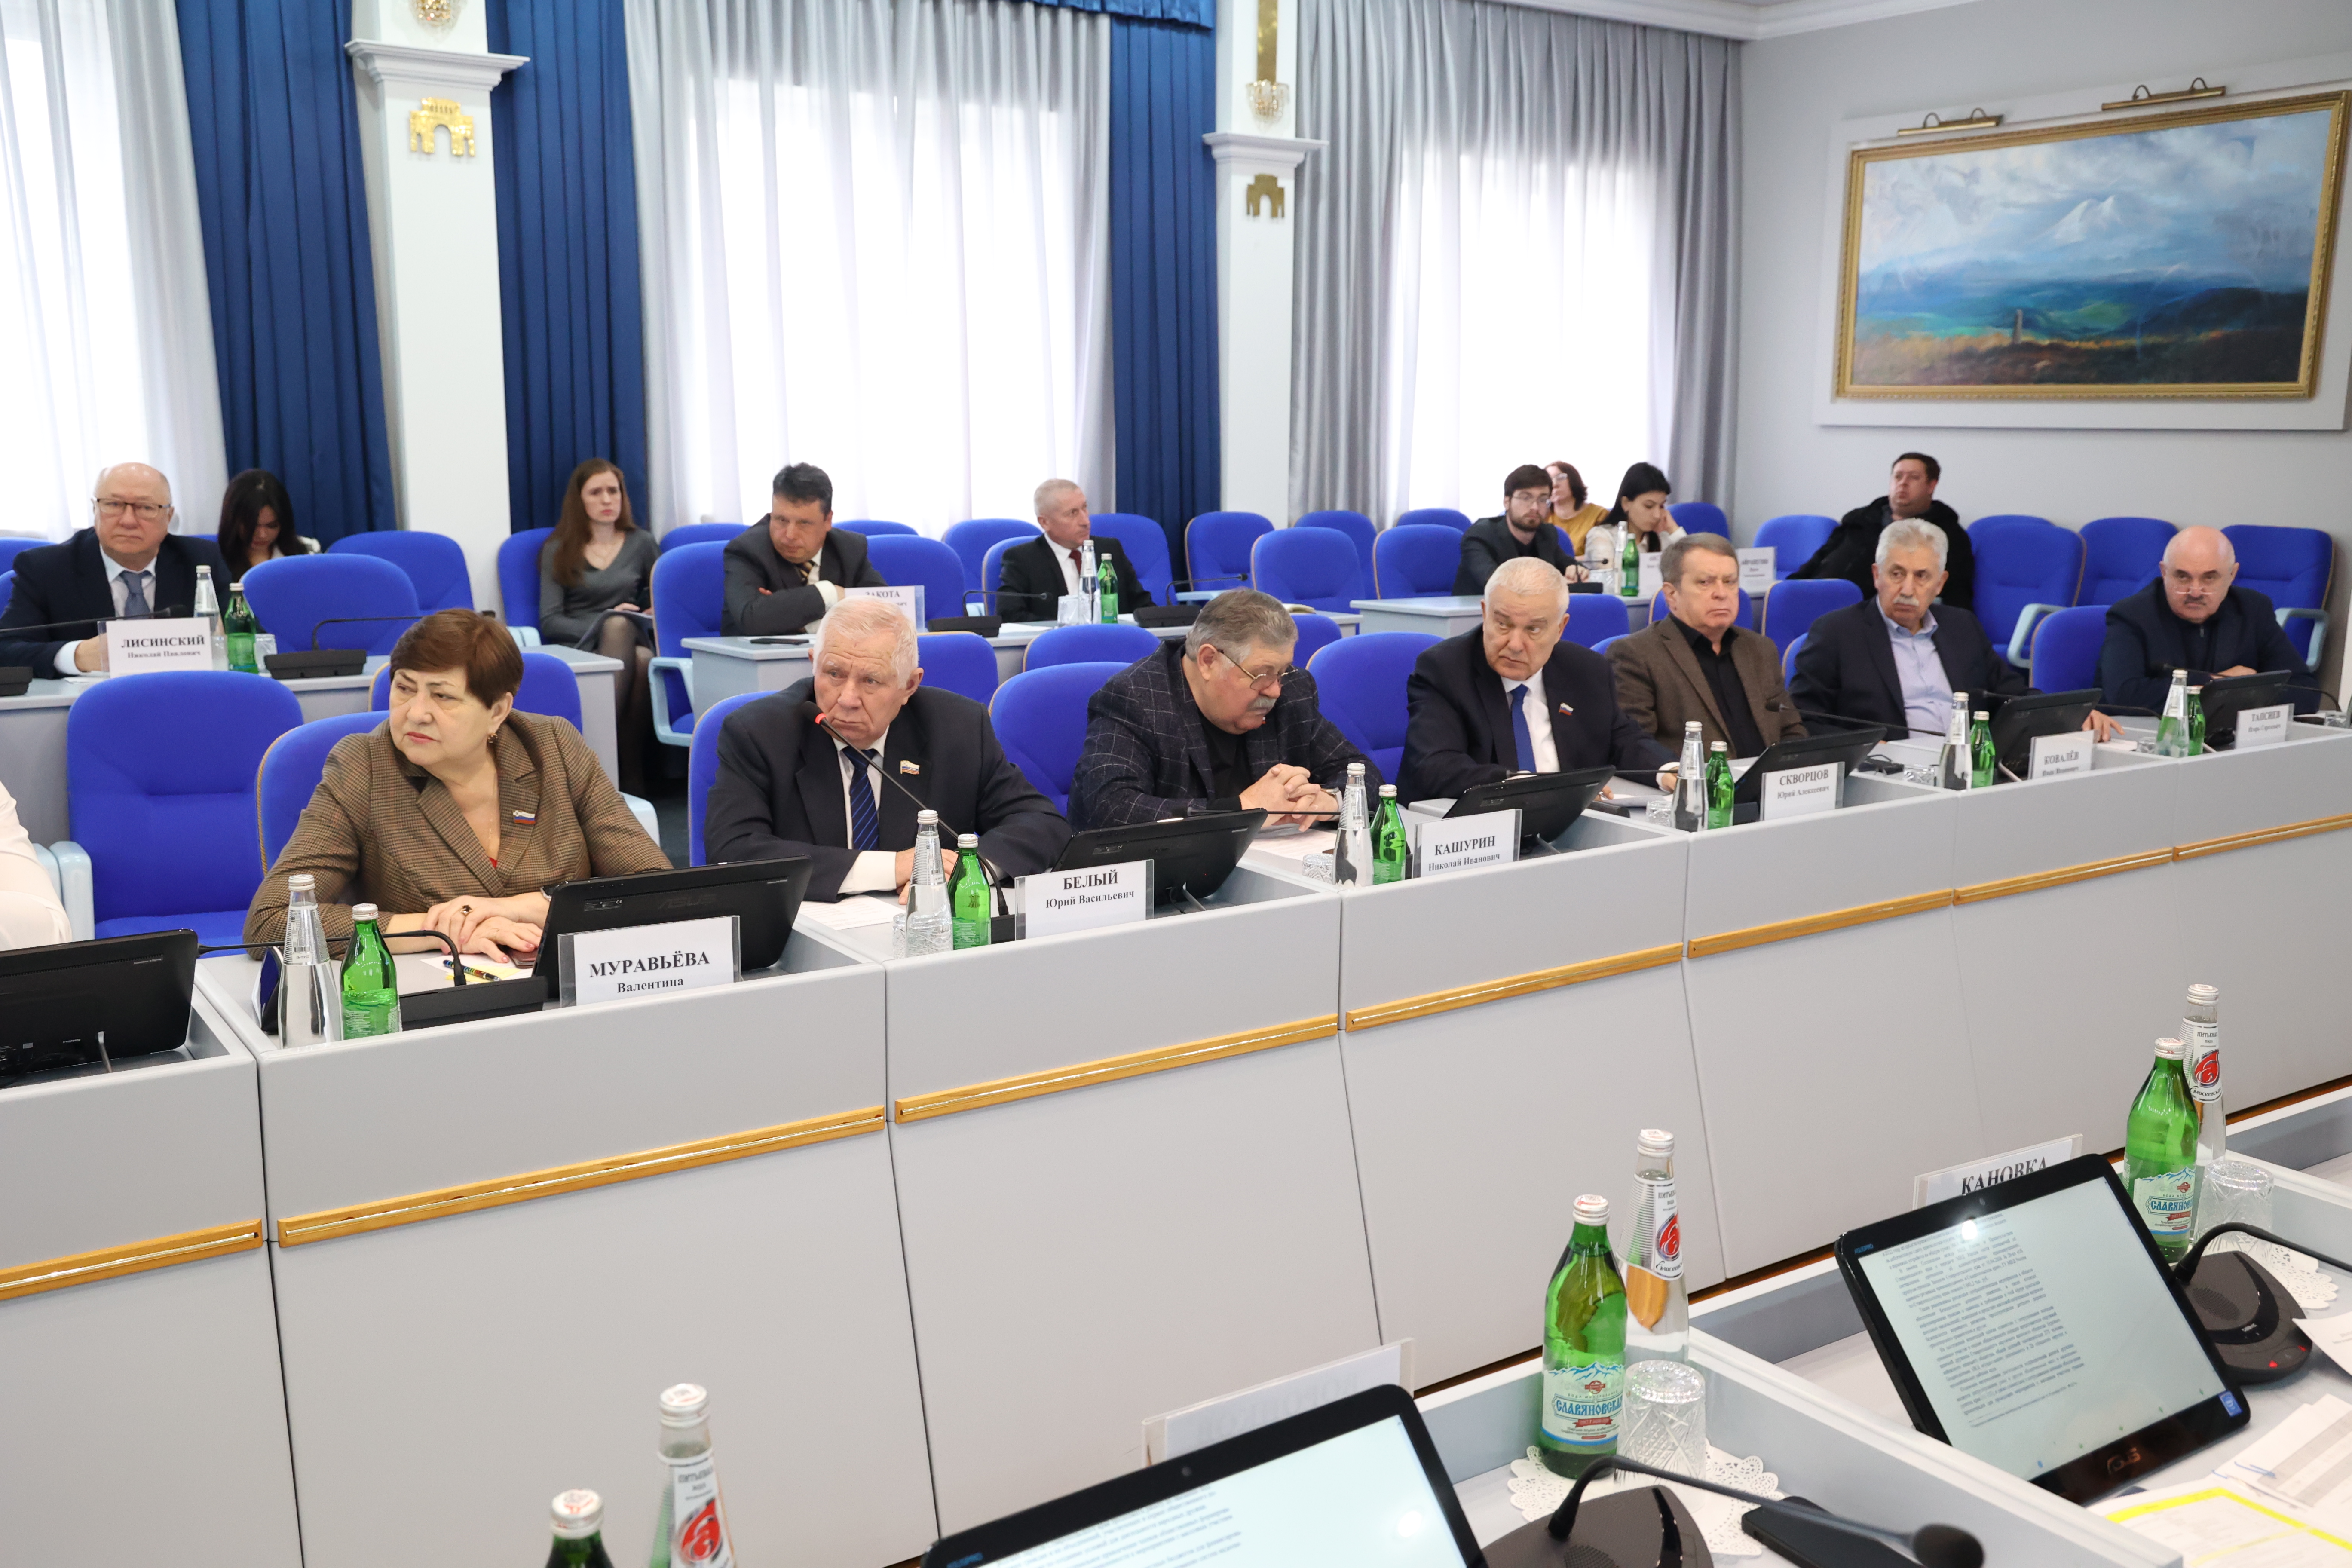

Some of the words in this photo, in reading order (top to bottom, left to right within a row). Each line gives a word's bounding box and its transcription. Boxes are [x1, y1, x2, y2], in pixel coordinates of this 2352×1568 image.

[121, 634, 205, 648] ЛИСИНСКИЙ
[2044, 750, 2079, 765] КОВАЛЁВ
[1779, 769, 1829, 786] СКВОРЦОВ
[1777, 790, 1795, 800] Юрий
[1798, 786, 1830, 795] Алексеевич
[1434, 836, 1496, 856] КАШУРИН
[1428, 859, 1461, 871] Николай
[1464, 854, 1500, 865] Иванович
[1063, 869, 1118, 890] БЕЛЫЙ
[1046, 897, 1076, 909] Юрий
[1079, 891, 1134, 904] Васильевич
[589, 950, 710, 977] МУРАВЬЁВА
[617, 978, 684, 993] Валентина
[1962, 1156, 2047, 1194] КАНОВКА
